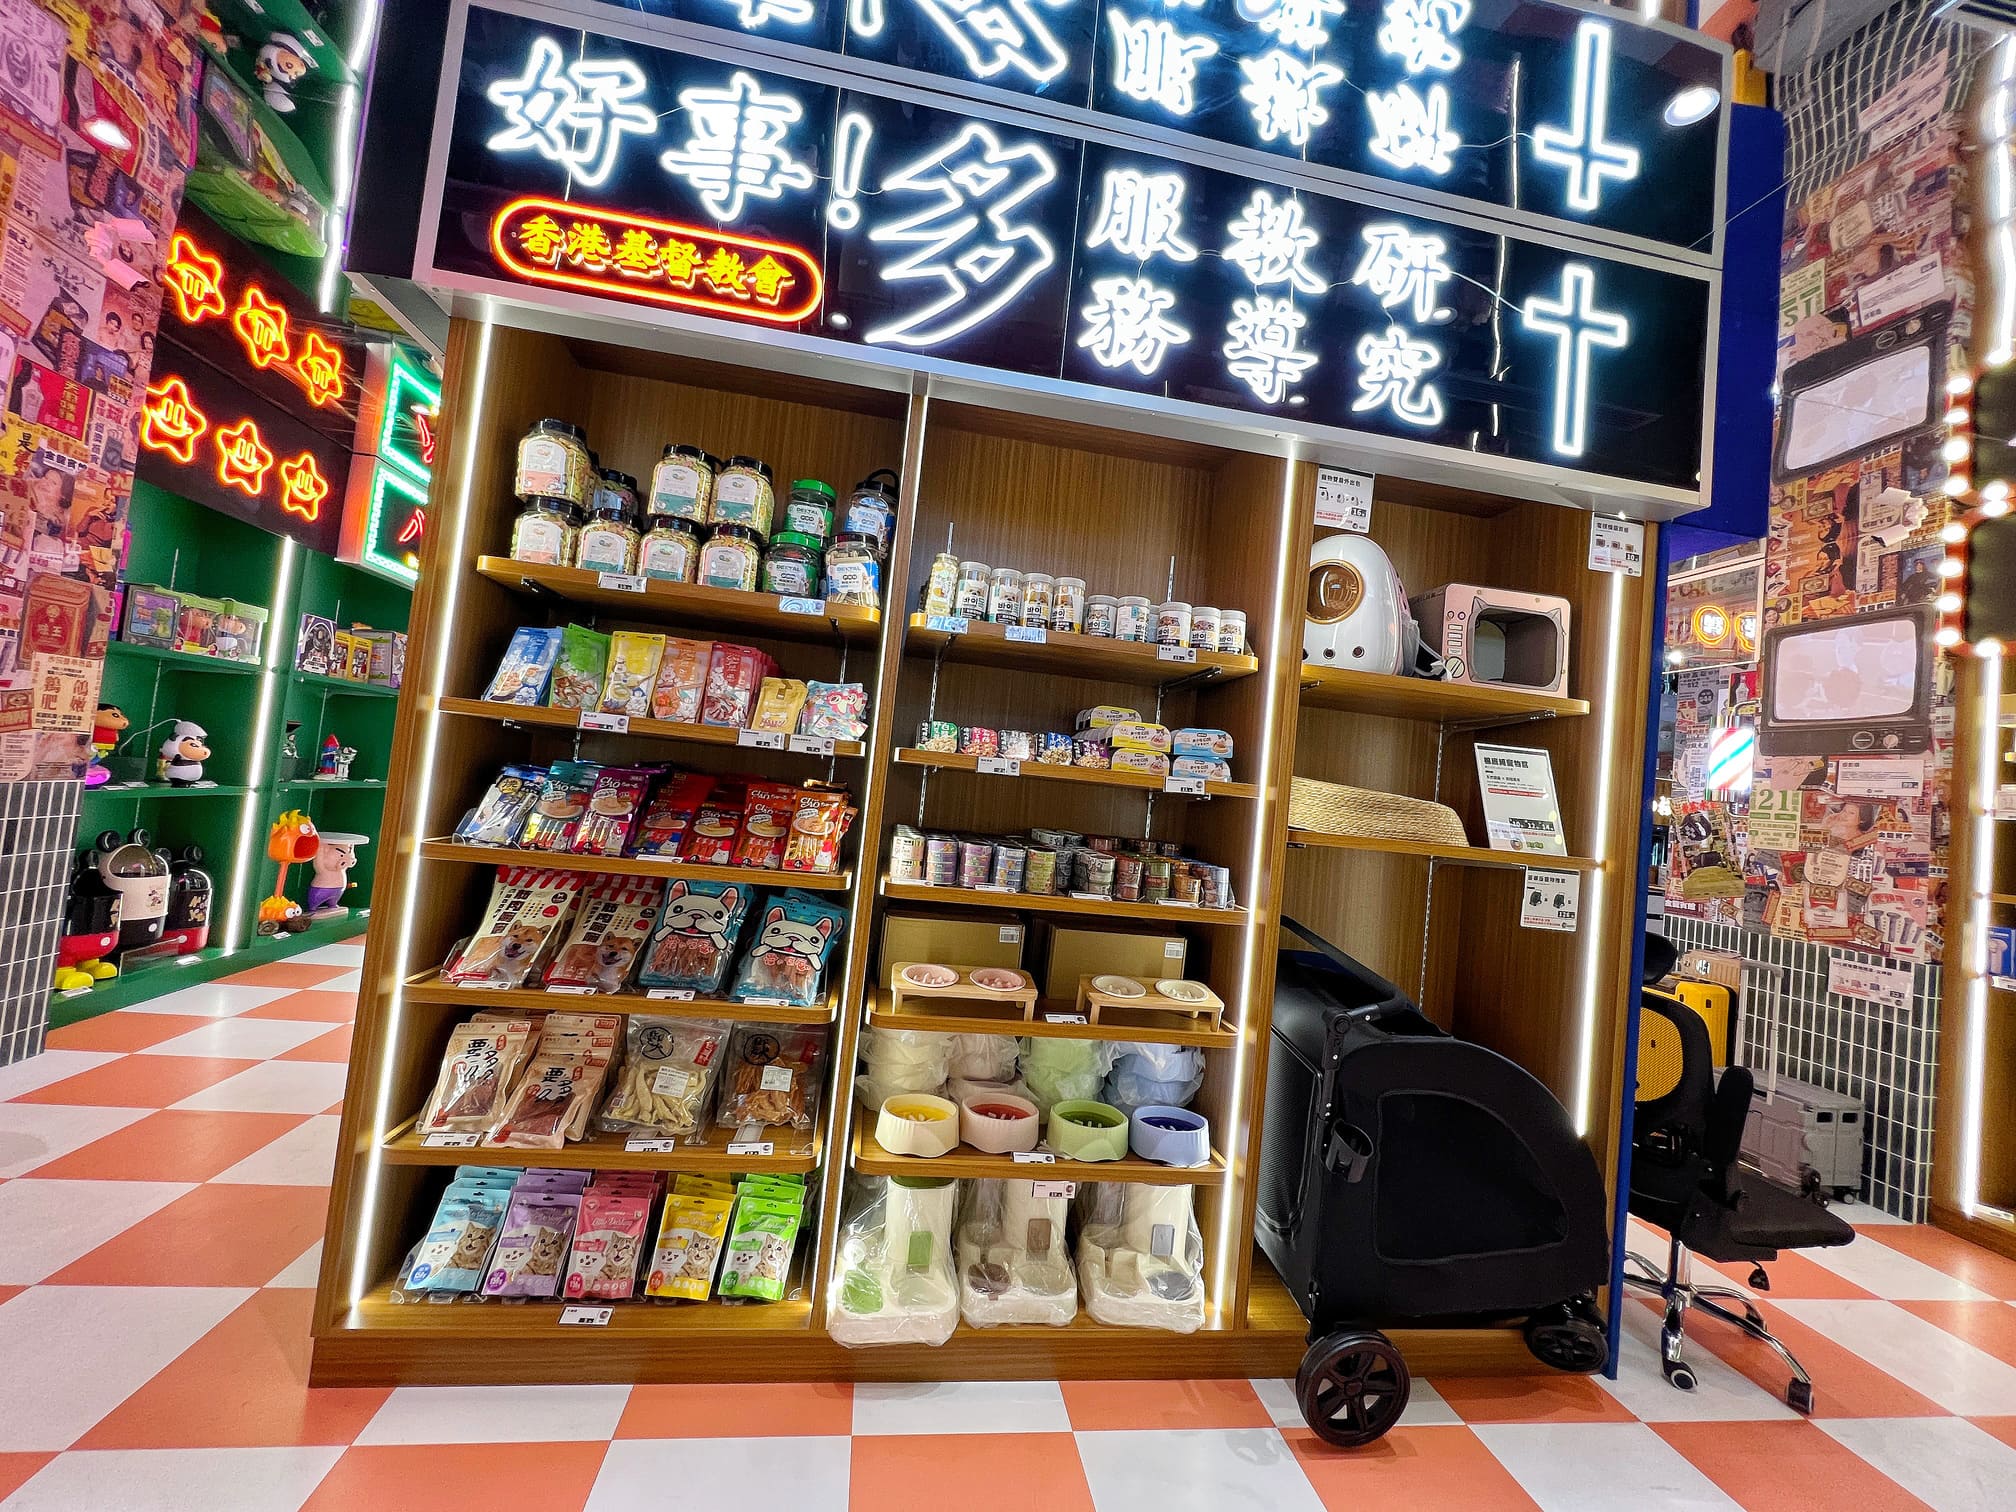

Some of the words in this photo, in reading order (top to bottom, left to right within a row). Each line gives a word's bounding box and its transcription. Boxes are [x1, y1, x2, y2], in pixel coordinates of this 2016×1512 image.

[519, 213, 797, 305] 香港基督教會
[1758, 788, 1789, 811] 21
